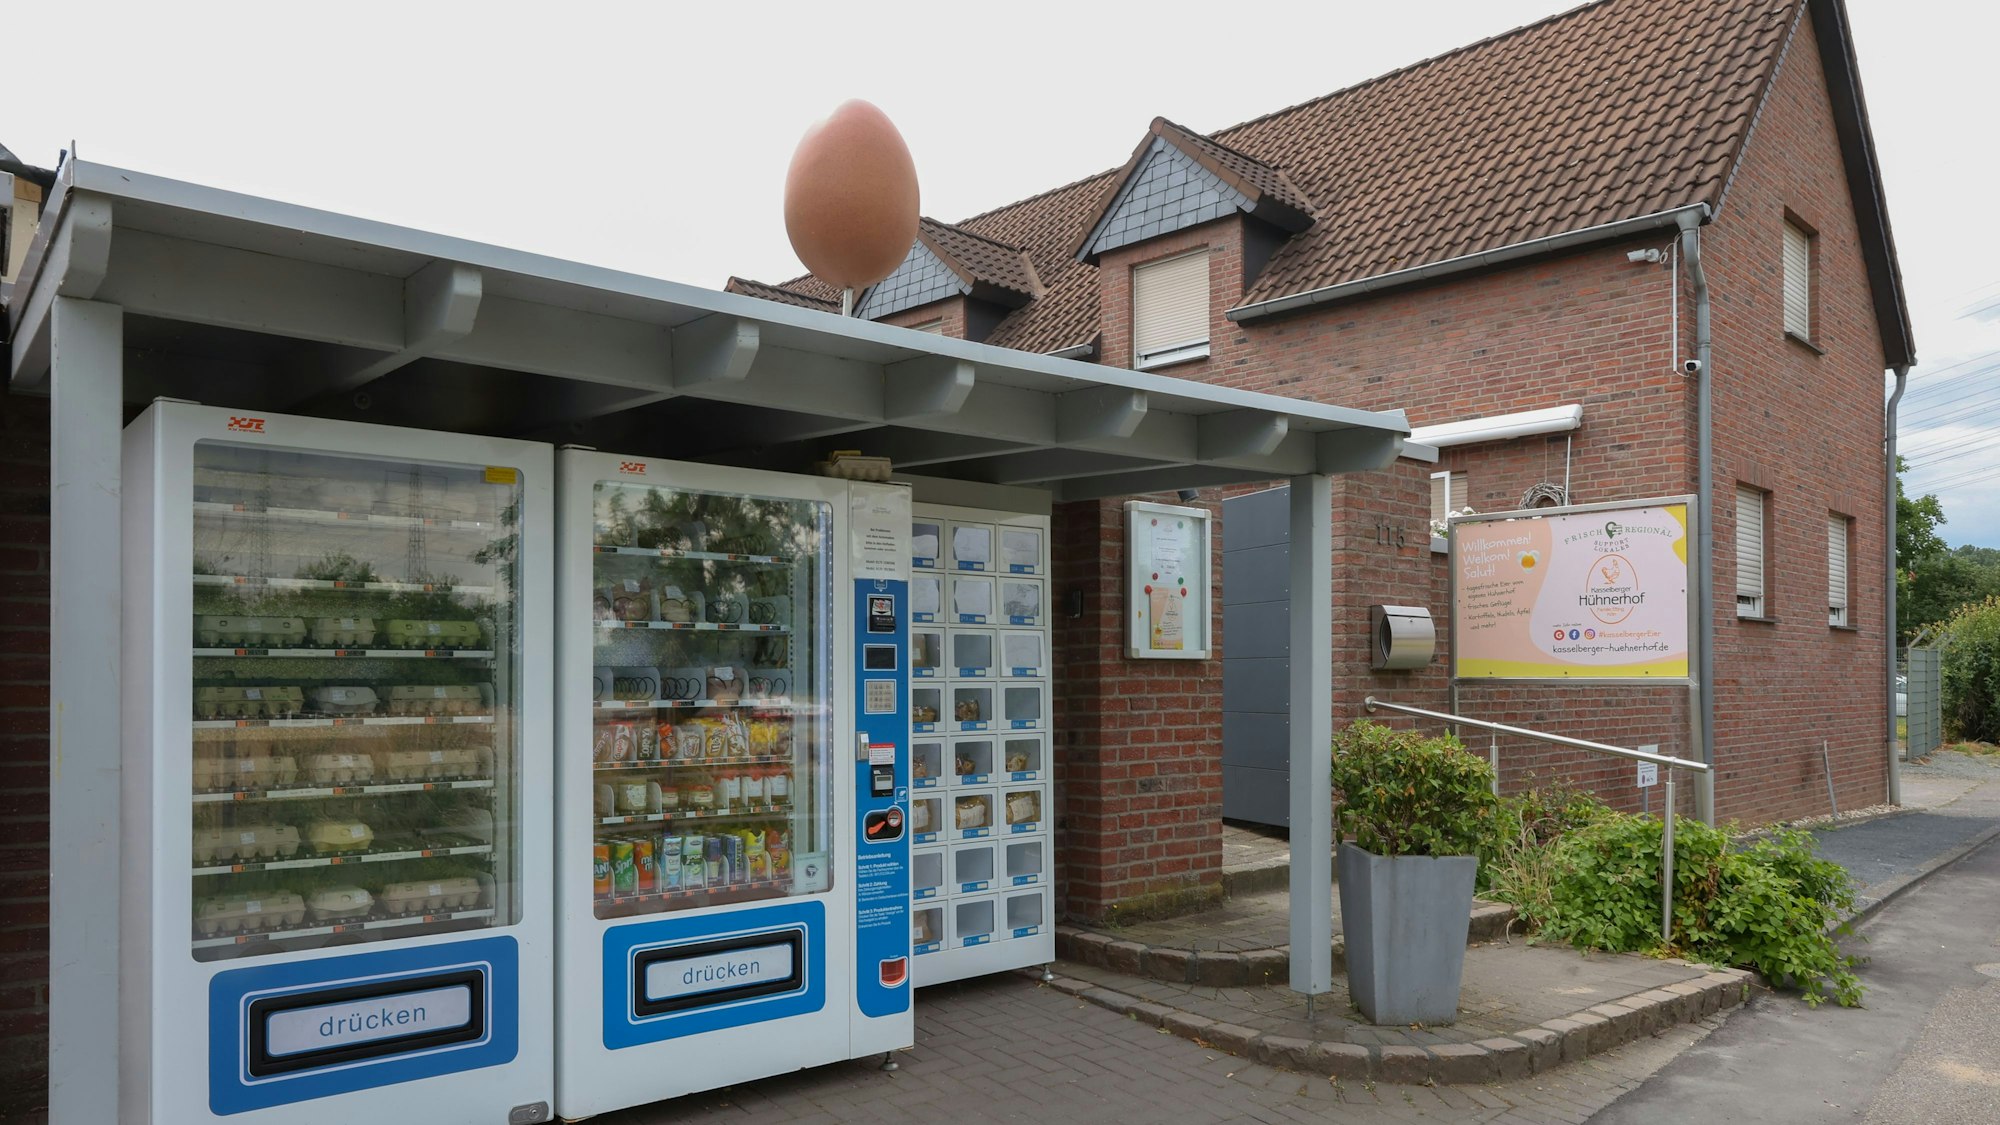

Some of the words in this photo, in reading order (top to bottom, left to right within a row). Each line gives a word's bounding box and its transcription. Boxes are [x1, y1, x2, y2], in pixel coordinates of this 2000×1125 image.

[1564, 529, 1602, 545] FRISCH
[1624, 526, 1673, 538] REGIONAL
[1462, 532, 1532, 553] Willkommen!
[1593, 537, 1630, 547] SUPPORT
[1593, 544, 1630, 553] LOKALES
[1463, 550, 1511, 566] Welkom!
[1464, 566, 1496, 580] Salut!
[1590, 586, 1632, 594] Kasselberger
[1490, 600, 1512, 609] Geflügel
[1579, 592, 1646, 607] Hühnerhof
[1552, 640, 1670, 656] kasselberger-huehnerhof.de
[683, 960, 760, 985] drücken
[319, 1005, 426, 1038] drücken
